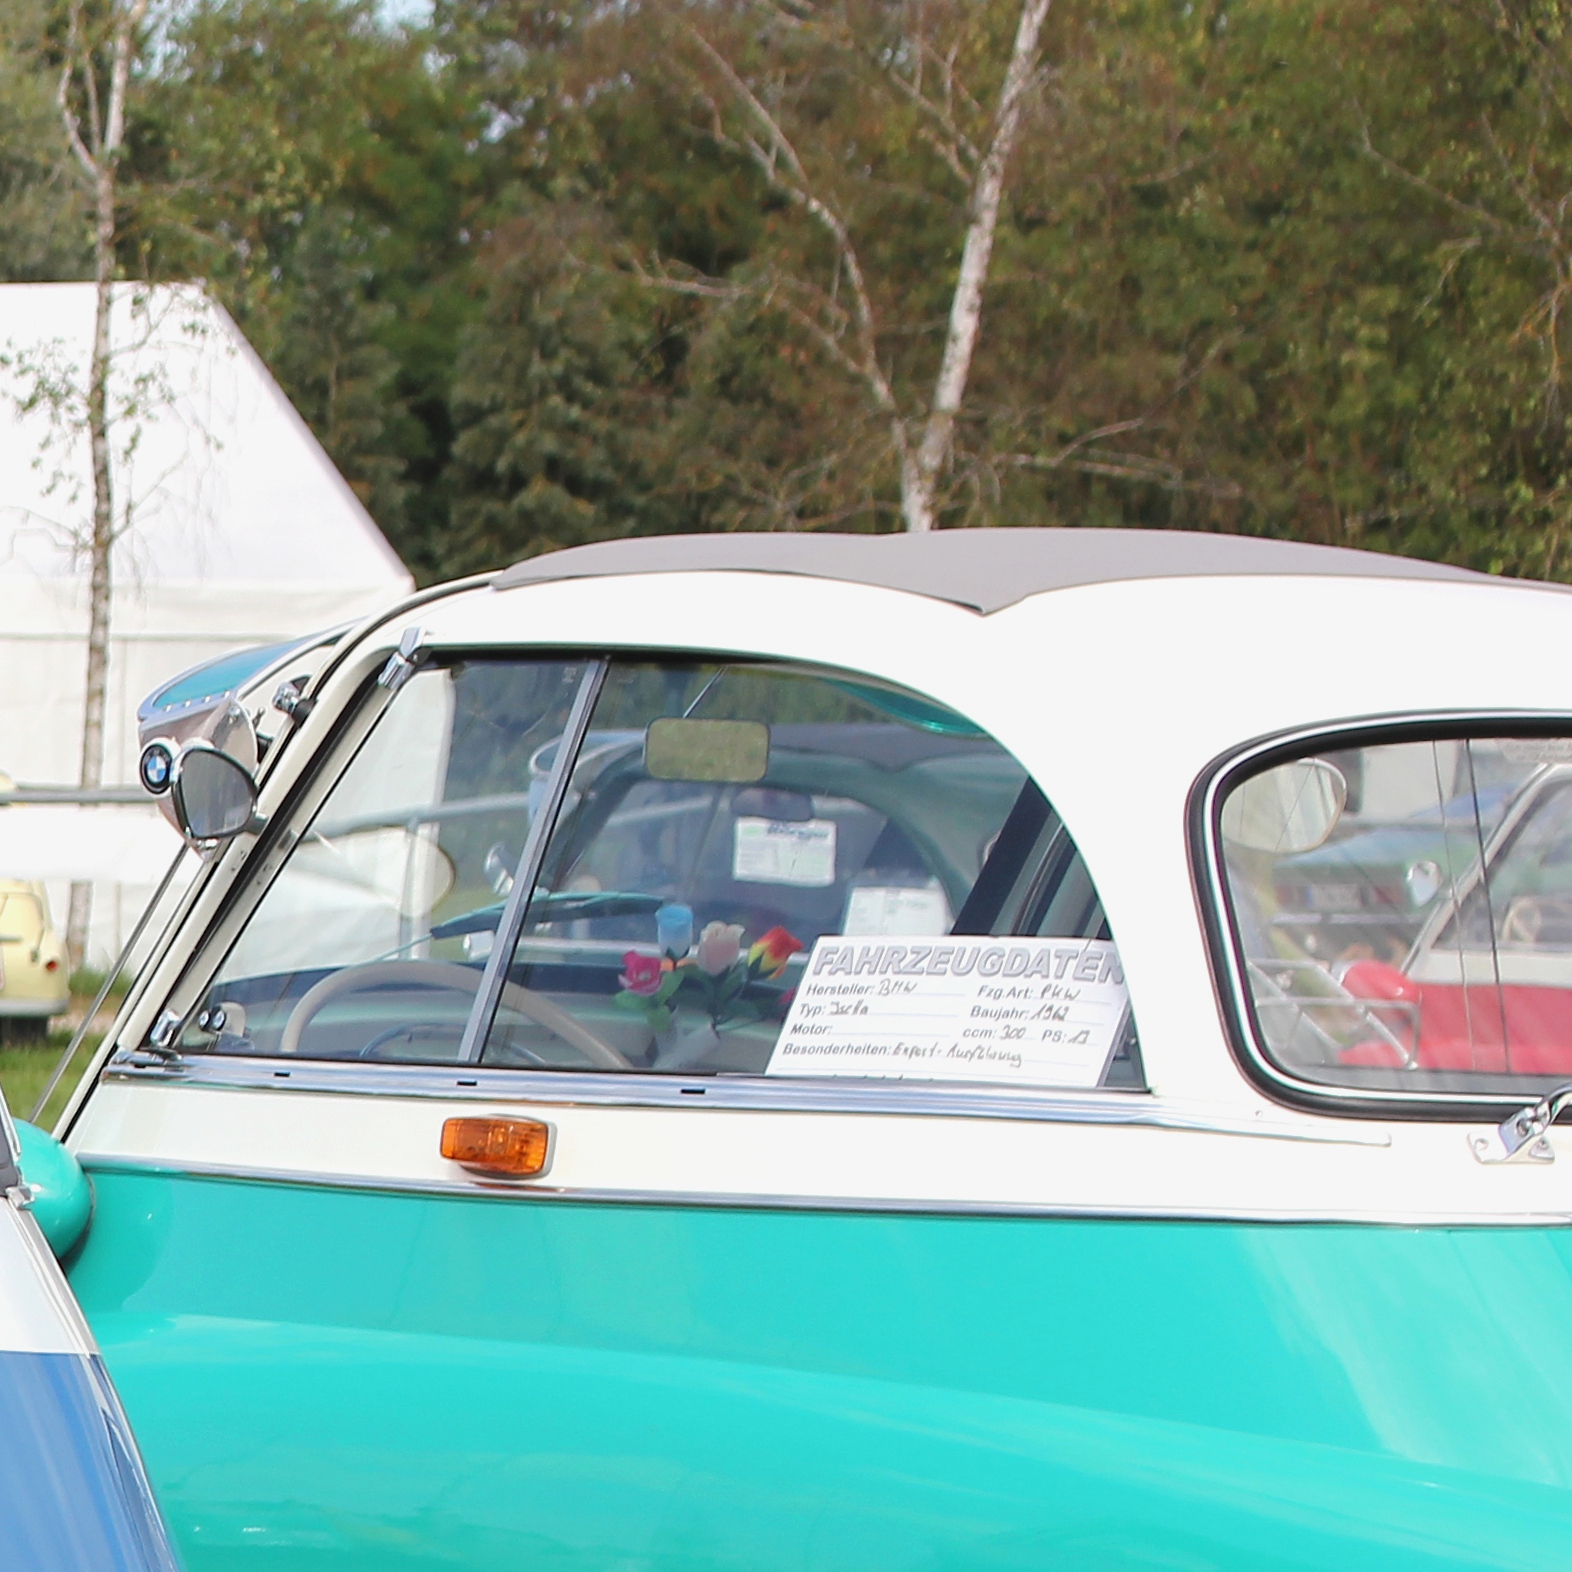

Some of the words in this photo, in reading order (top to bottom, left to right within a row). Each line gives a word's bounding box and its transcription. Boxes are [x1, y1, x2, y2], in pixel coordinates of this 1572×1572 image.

[812, 945, 1125, 985] FAHRZEUGDATEN
[806, 982, 875, 996] Hersteller:
[977, 985, 1034, 1000] Fzg.Art:
[799, 1003, 826, 1018] Typ:
[970, 1005, 1029, 1021] Baujahr:
[789, 1023, 833, 1036] Motor:
[962, 1028, 997, 1040] ccm:
[999, 1024, 1027, 1040] 300
[782, 1043, 892, 1056] Besonderheiten:
